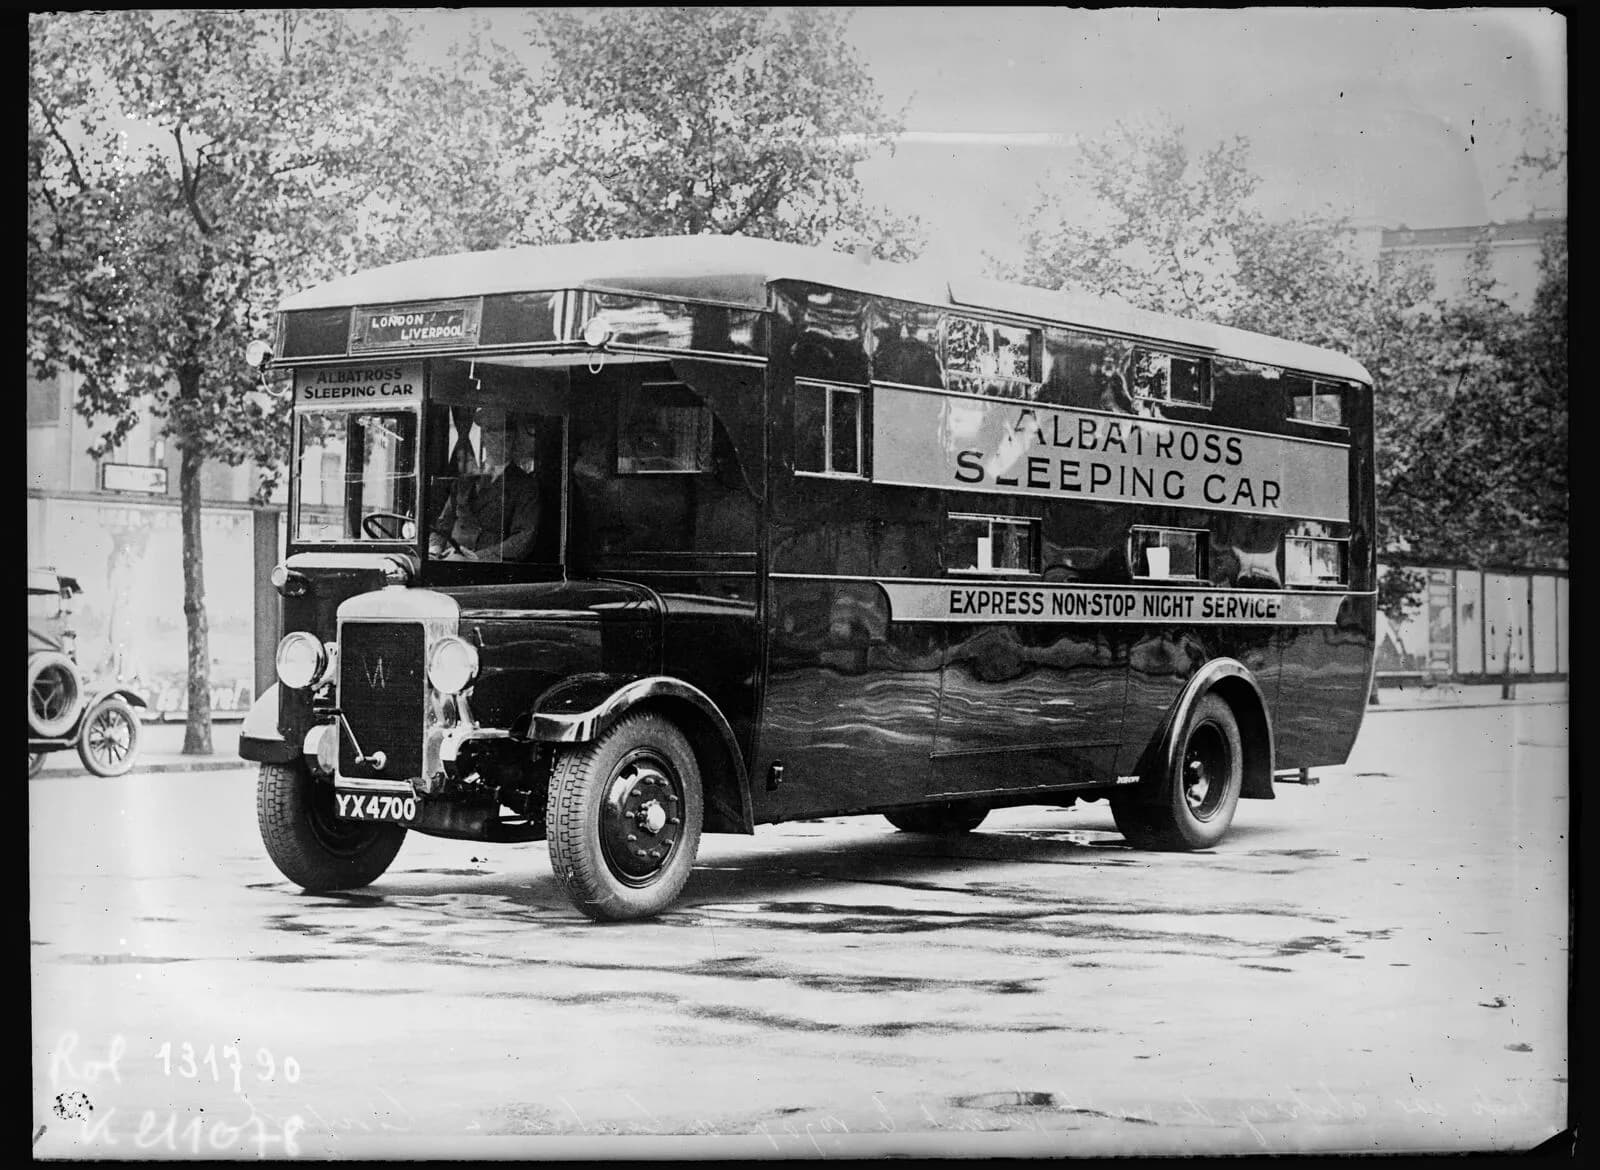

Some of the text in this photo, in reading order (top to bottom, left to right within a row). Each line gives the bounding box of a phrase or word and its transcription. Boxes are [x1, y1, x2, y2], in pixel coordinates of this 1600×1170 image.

[371, 313, 425, 329] LONDON
[400, 325, 464, 341] LIVERPOOL
[316, 367, 402, 384] ALBATROSS
[304, 382, 414, 400] SLEEPING CAR
[1008, 408, 1244, 466] ALBATROSS
[1203, 473, 1282, 509] CAR
[949, 590, 1045, 617] EXPRESS
[1142, 596, 1195, 619] NIGHT
[335, 793, 417, 821] YX4700
